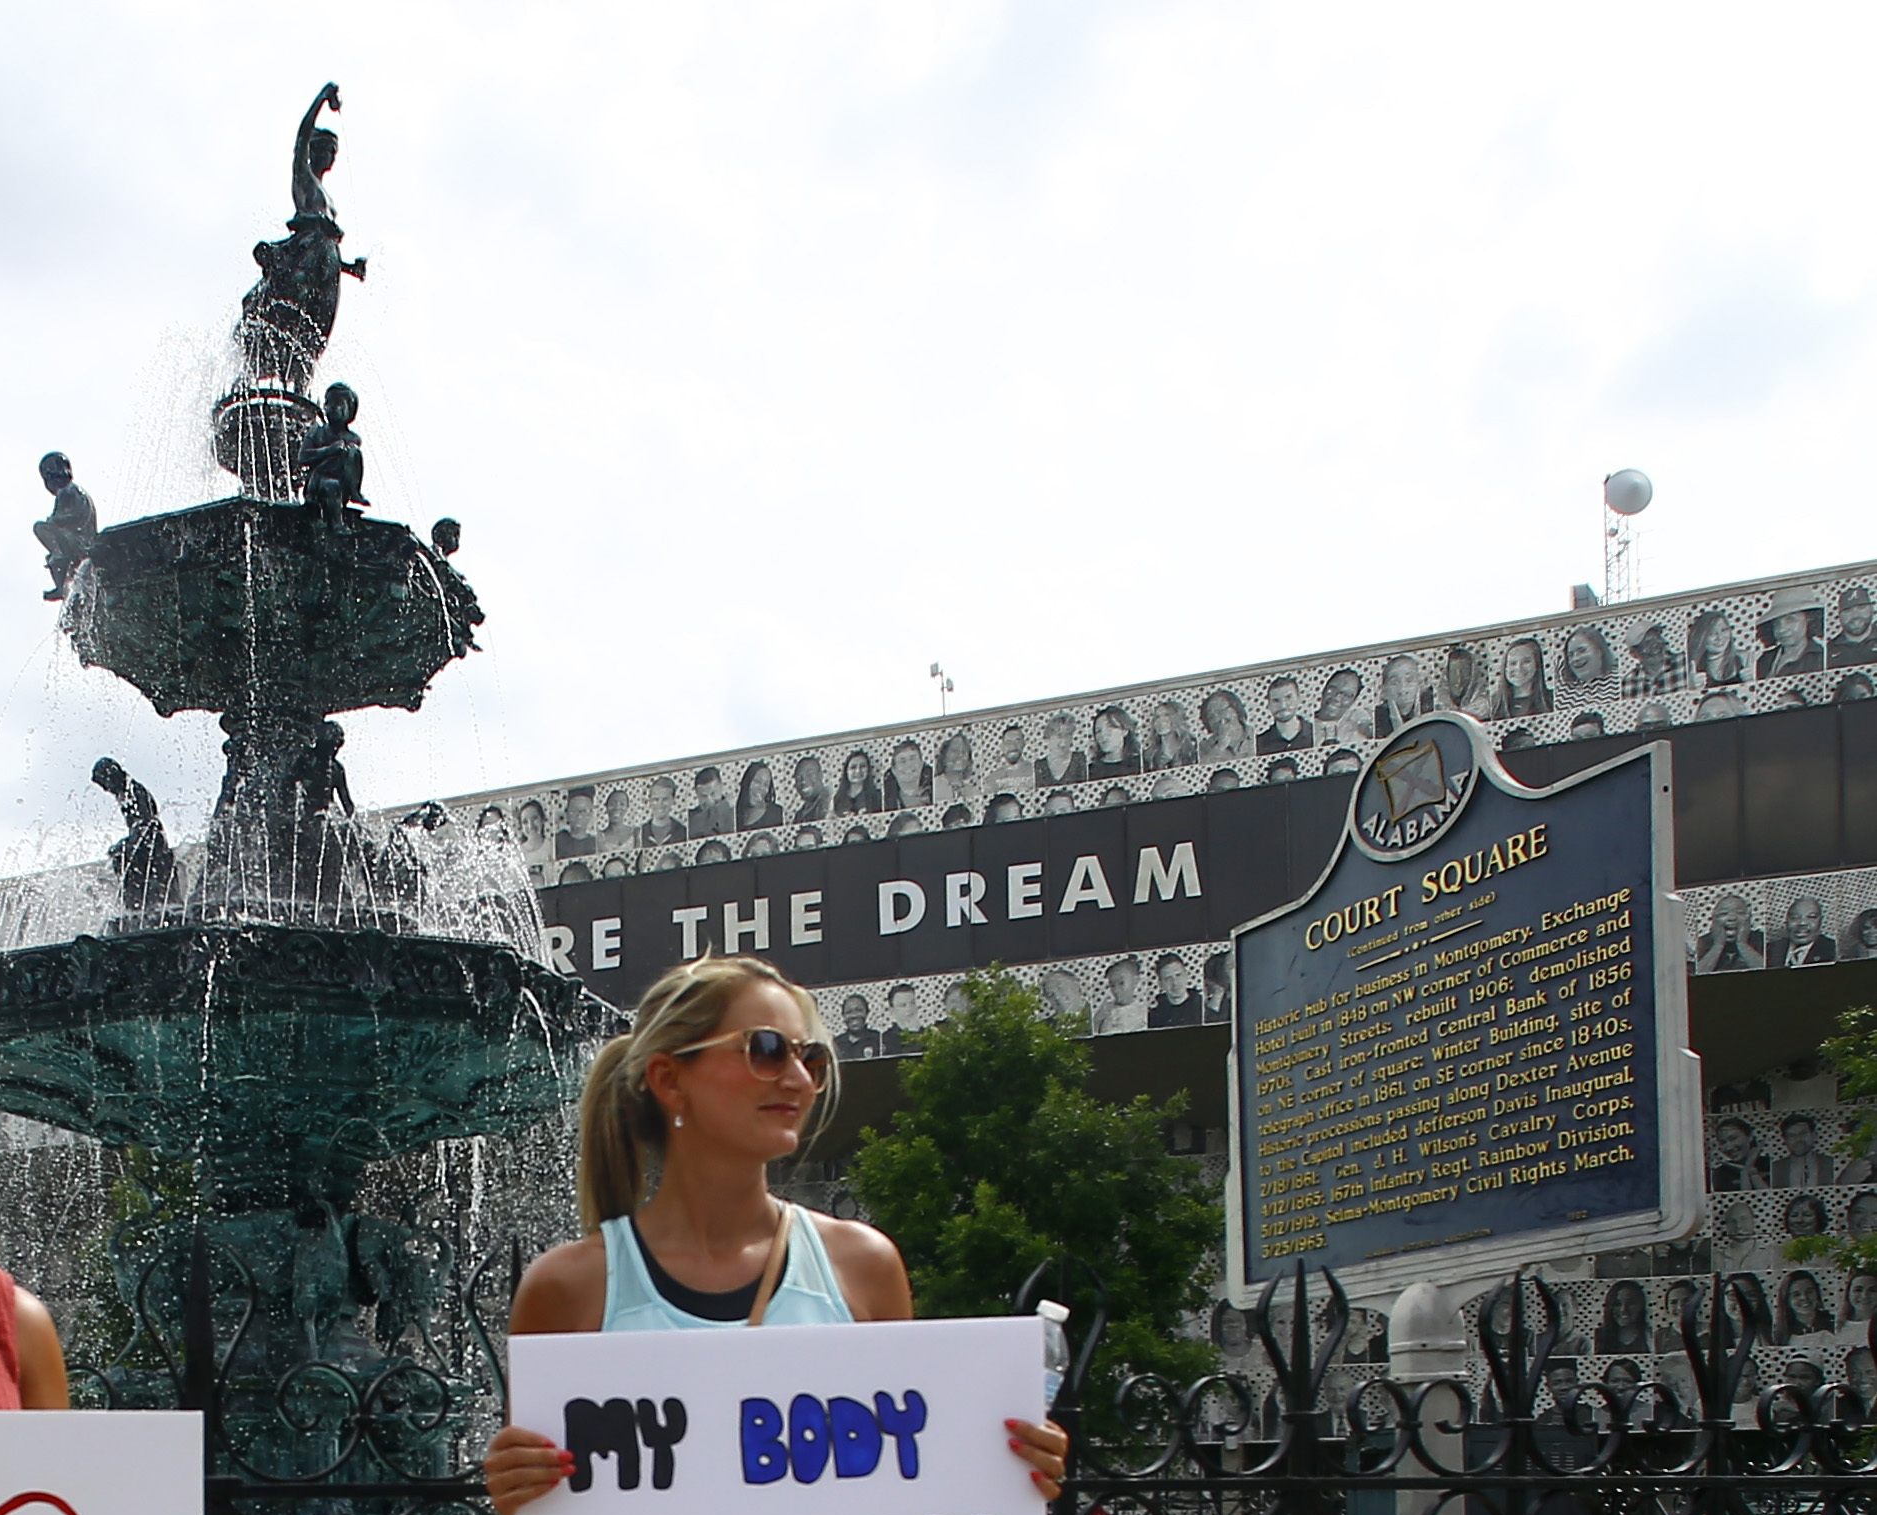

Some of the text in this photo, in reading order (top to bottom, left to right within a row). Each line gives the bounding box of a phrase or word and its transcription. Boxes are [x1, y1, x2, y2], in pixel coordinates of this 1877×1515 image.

[1362, 769, 1470, 848] ALABAMA
[673, 891, 823, 959] THE
[878, 841, 1203, 936] DREAM
[1304, 823, 1548, 950] COURT SQUARE
[1404, 920, 1429, 936] from
[1434, 906, 1463, 924] other
[1468, 891, 1496, 911] side)
[1255, 1008, 1301, 1036] Historic
[1305, 998, 1328, 1018] hub
[1331, 991, 1351, 1008] for
[1355, 968, 1411, 999] business
[1414, 961, 1428, 977] in
[1541, 887, 1631, 931] Exchange
[1255, 910, 1631, 1057] Hotel built in 1848 on NW corner of Commerce and
[1255, 1044, 1330, 1077] Montgomery
[1405, 995, 1458, 1026] rebuilt
[1528, 935, 1631, 984] demolished
[1257, 1103, 1272, 1116] on
[1278, 1092, 1295, 1110] NE
[1299, 1080, 1344, 1104] corner
[1349, 1070, 1365, 1088] of
[1431, 1036, 1481, 1061] Winter
[1570, 999, 1603, 1021] site
[1611, 986, 1632, 1009] of
[1258, 1111, 1315, 1136] telegraph
[1318, 1098, 1355, 1119] office
[1358, 1092, 1371, 1107] in
[1412, 1076, 1431, 1092] on
[1436, 1065, 1456, 1085] SE
[1459, 1051, 1514, 1077] corner
[1519, 1036, 1565, 1061] since
[1571, 1016, 1633, 1046] 1840s.
[1304, 1061, 1333, 1081] Cast
[1339, 1027, 1429, 1070] iron-fronted
[1437, 1004, 1496, 1038] Central
[1506, 990, 1547, 1016] Bank
[1558, 978, 1578, 999] of
[1588, 961, 1632, 991] 1856
[1258, 1042, 1634, 1157] Historic processions passing along Dexter Avenue
[1259, 1164, 1272, 1176] to
[1277, 1157, 1297, 1172] the
[1301, 1141, 1344, 1166] Capitol
[1350, 1124, 1408, 1153] included
[1414, 1107, 1487, 1137] Jefferson
[1493, 1091, 1539, 1116] Davis
[1332, 1162, 1363, 1179] Gen.
[1373, 1152, 1386, 1169] J.
[1392, 1147, 1408, 1165] H.
[1418, 1129, 1478, 1157] Wilson's
[1489, 1113, 1558, 1141] Cavalry
[1325, 1184, 1459, 1225] Selma-Montgomery
[1466, 1171, 1504, 1193] Civil
[1510, 1159, 1568, 1185] Rights
[1330, 1181, 1365, 1203] 167th
[1370, 1168, 1426, 1192] Infantry
[1431, 1156, 1473, 1178] Regt.
[1478, 1139, 1551, 1168] Rainbow
[563, 1389, 929, 1492] MY BODY
